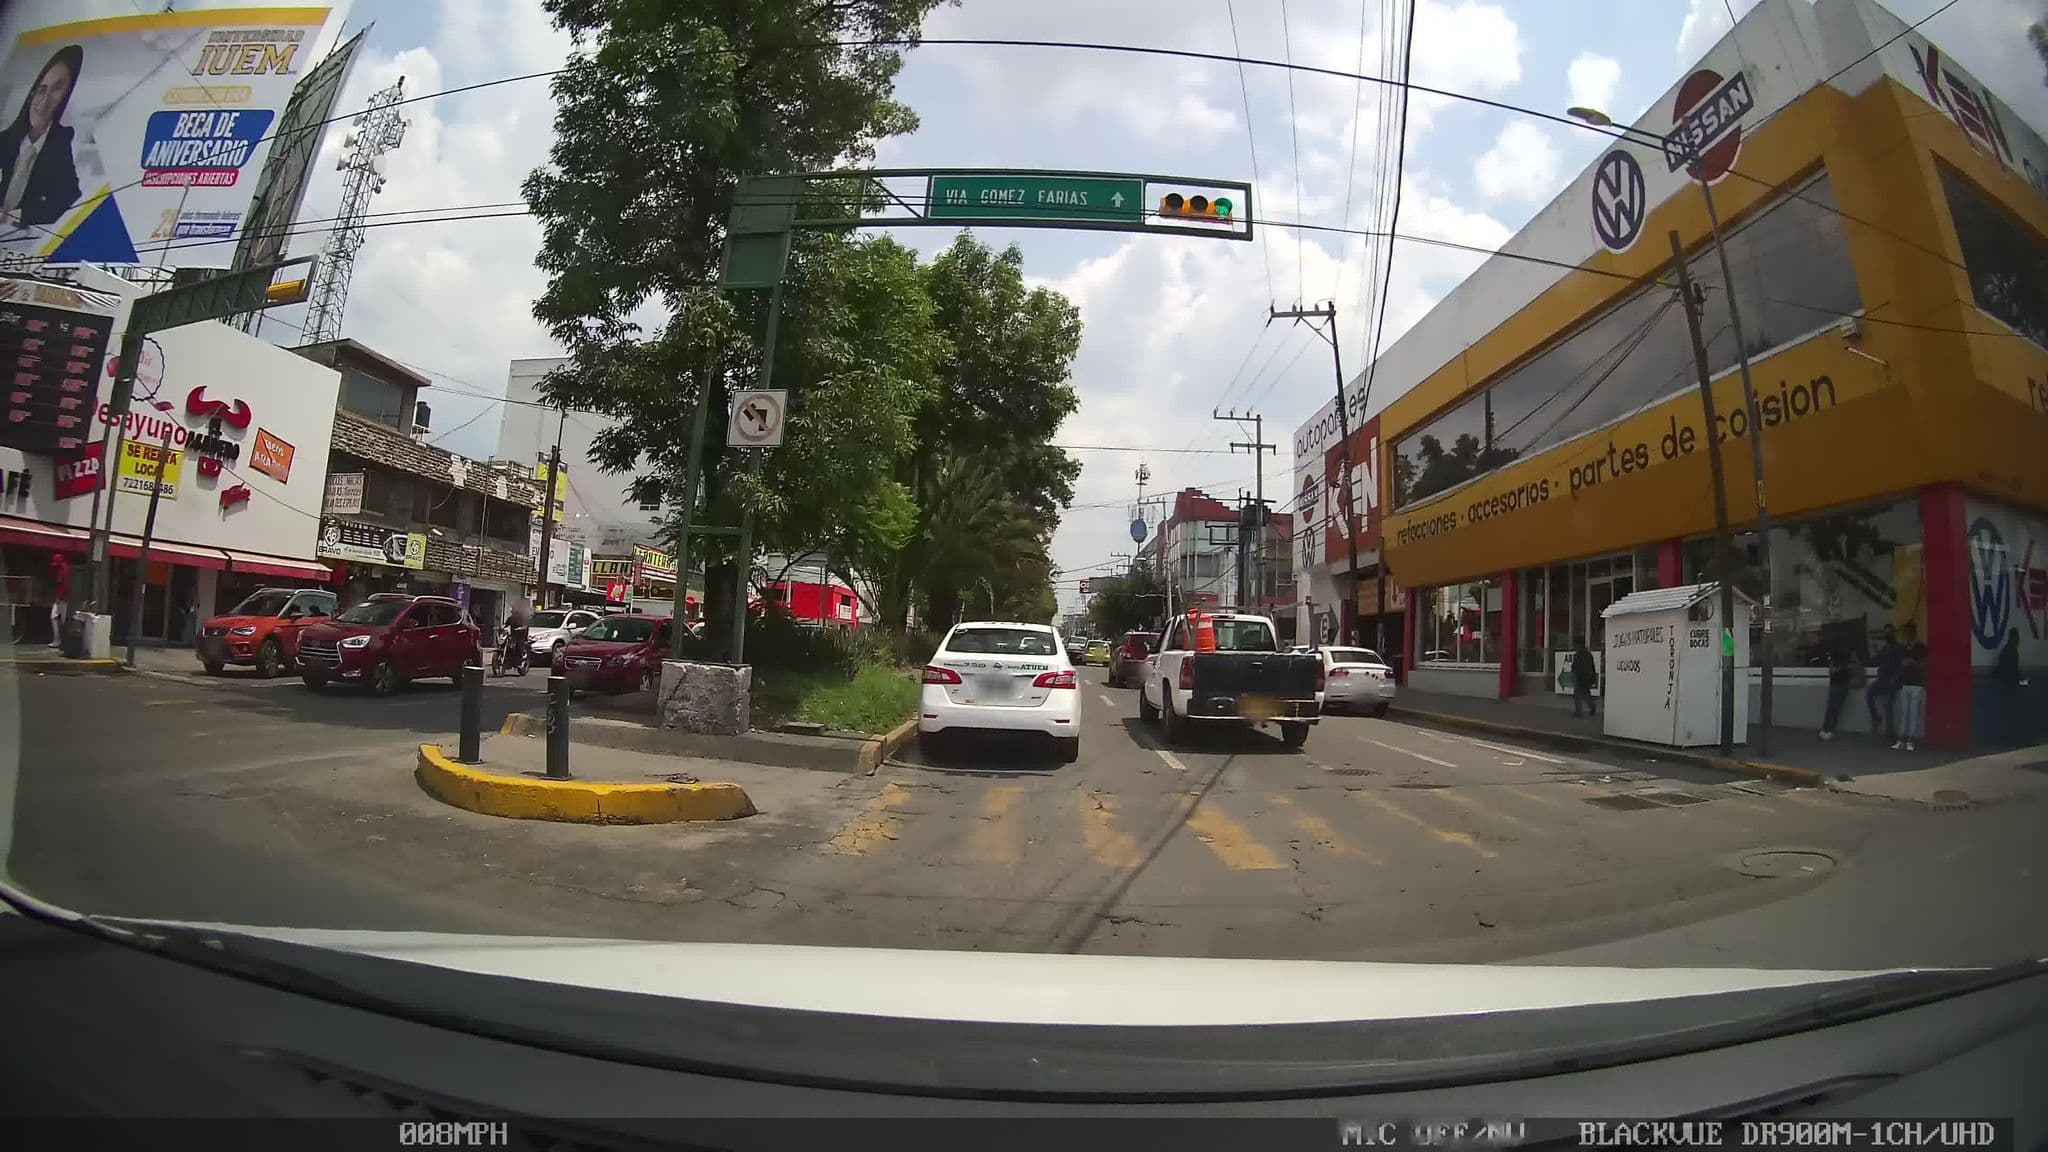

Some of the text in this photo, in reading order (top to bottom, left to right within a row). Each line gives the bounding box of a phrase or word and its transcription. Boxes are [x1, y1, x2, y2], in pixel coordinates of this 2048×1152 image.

[192, 44, 298, 75] IUEM
[172, 112, 240, 138] BECA DE
[1666, 80, 1750, 165] NISSAN
[144, 140, 249, 167] ANIVERSARIO
[198, 173, 236, 185] ABIERTAS
[946, 189, 1088, 206] VIA GOMEZ FARIAS
[127, 444, 141, 458] SE
[1396, 511, 1457, 547] refacciones
[1467, 478, 1550, 524] accesorios
[1568, 441, 1650, 498] partes
[1661, 415, 1696, 460] de
[319, 545, 341, 555] BRAVO
[1690, 629, 1710, 639] CUBRE
[1689, 639, 1710, 649] BOCAS
